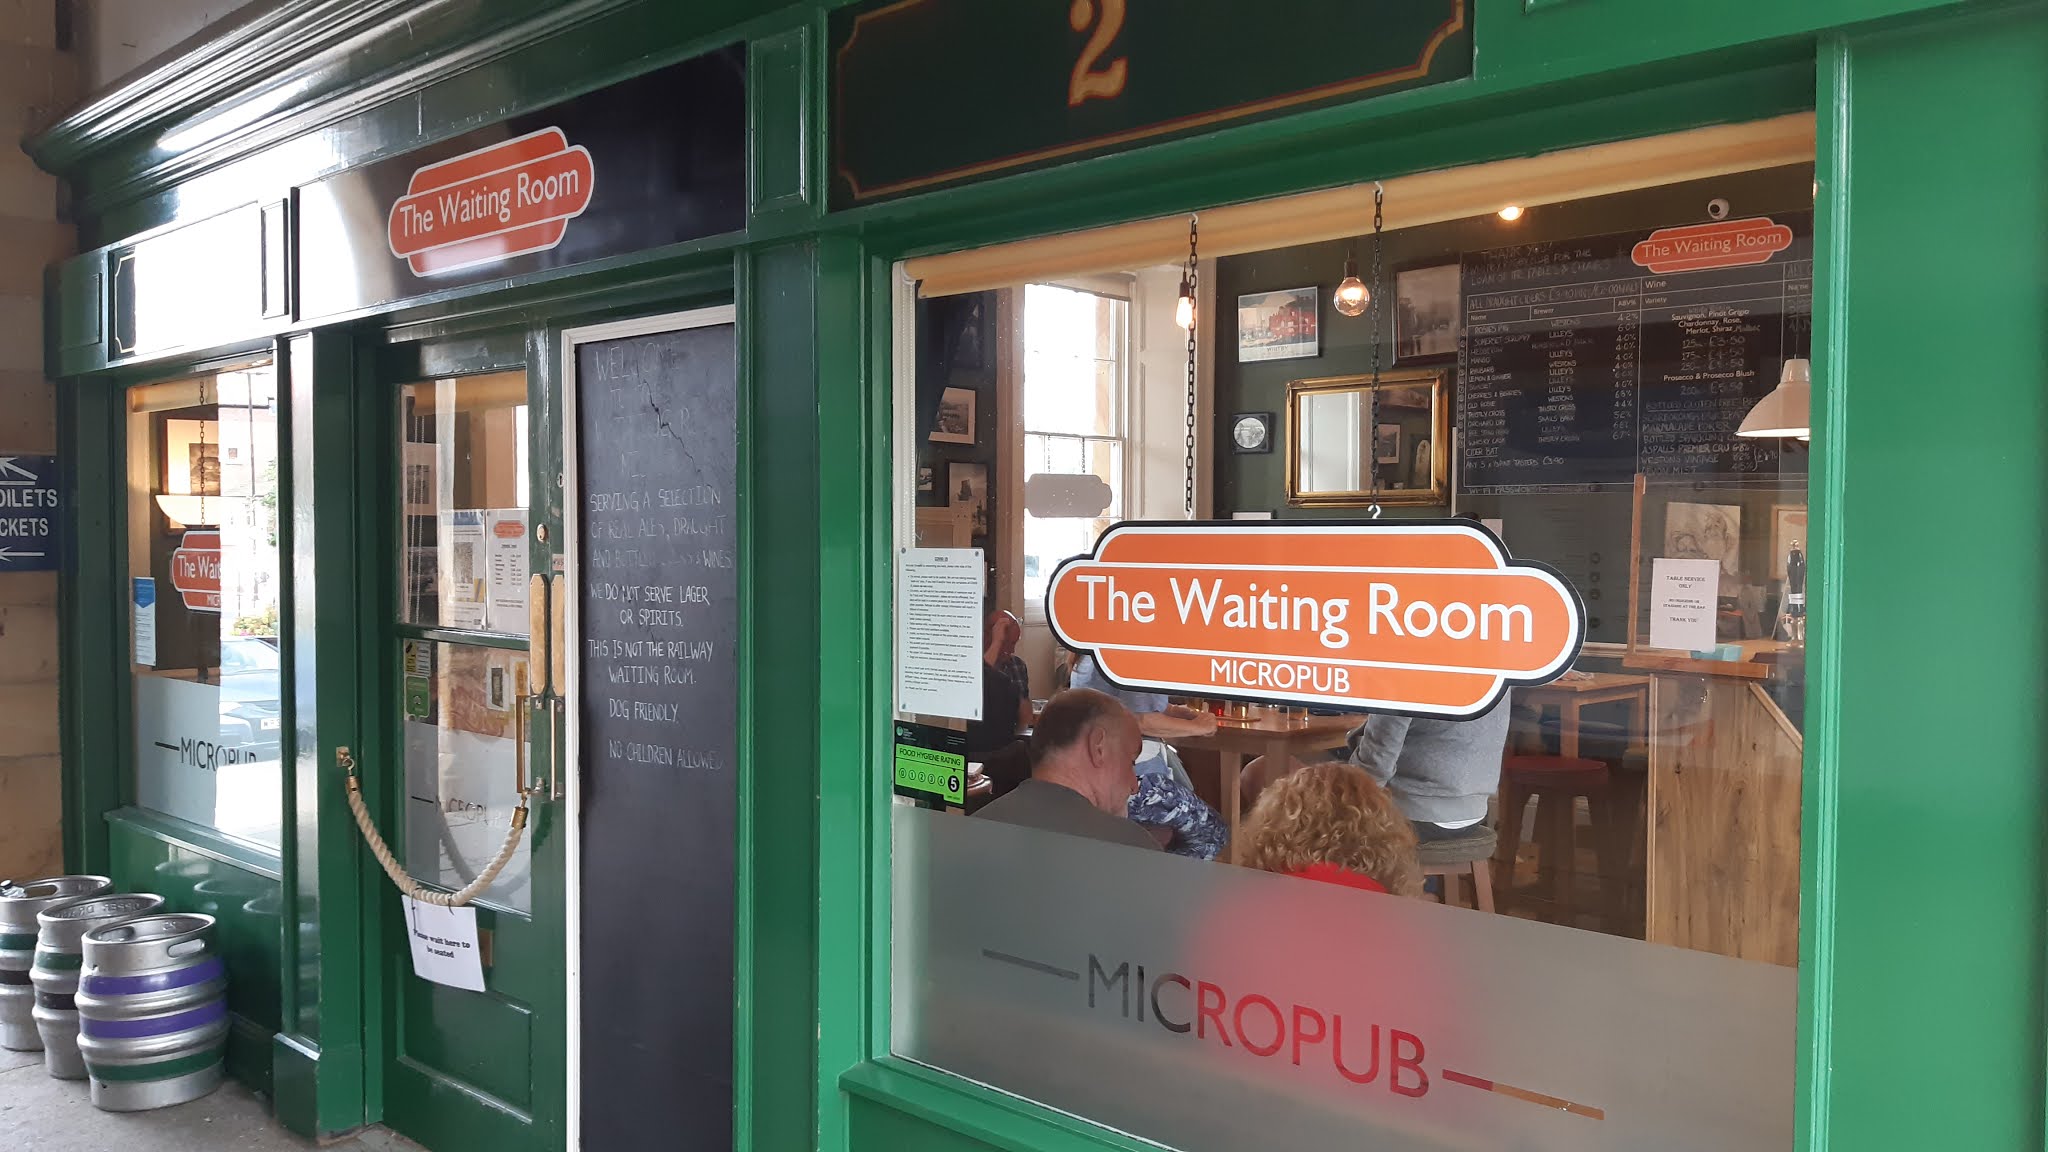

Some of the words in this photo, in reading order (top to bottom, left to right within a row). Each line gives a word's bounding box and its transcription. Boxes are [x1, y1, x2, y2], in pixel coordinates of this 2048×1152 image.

[1069, 0, 1128, 107] 2
[400, 204, 434, 237] The
[439, 187, 511, 223] Waiting
[517, 169, 579, 208] Room
[1642, 244, 1670, 258] The
[1675, 238, 1731, 252] Waiting
[1736, 233, 1782, 247] Room
[1645, 280, 1667, 288] Wine
[1533, 307, 1555, 315] Brewer
[1645, 297, 1667, 305] Variety
[1709, 310, 1726, 318] Pinot
[594, 341, 680, 381] WELOME
[1663, 373, 1694, 382] Prosecco
[1695, 372, 1701, 380] &
[1702, 371, 1734, 380] Prosecco
[1736, 369, 1755, 377] Blush
[590, 492, 639, 512] SERVING
[643, 492, 650, 509] A
[658, 485, 721, 508] SELECTION
[177, 555, 196, 578] The
[198, 555, 221, 579] Wait
[590, 582, 603, 599] WE
[605, 583, 618, 600] DO
[622, 585, 640, 603] NOT
[644, 585, 674, 603] SERVE
[680, 585, 710, 606] LAGER
[620, 608, 634, 625] OR
[1076, 575, 1156, 624] The
[1169, 577, 1350, 649] Waiting
[1368, 582, 1534, 643] Room
[588, 639, 609, 658] THIS
[613, 639, 623, 659] IS
[625, 641, 643, 658] NOT
[646, 641, 664, 657] THE
[667, 641, 714, 662] RAILWAY
[608, 665, 659, 686] WAITING
[1210, 658, 1350, 694] MICROPUB
[609, 698, 629, 720] DOG
[609, 739, 622, 758] NO
[627, 742, 672, 765] CHILDREN
[900, 748, 916, 756] FOOD
[917, 751, 939, 762] HYGIENE
[941, 755, 961, 766] RATING
[950, 777, 957, 790] 5
[445, 939, 461, 948] here
[1088, 952, 1431, 1099] MICROPUB
